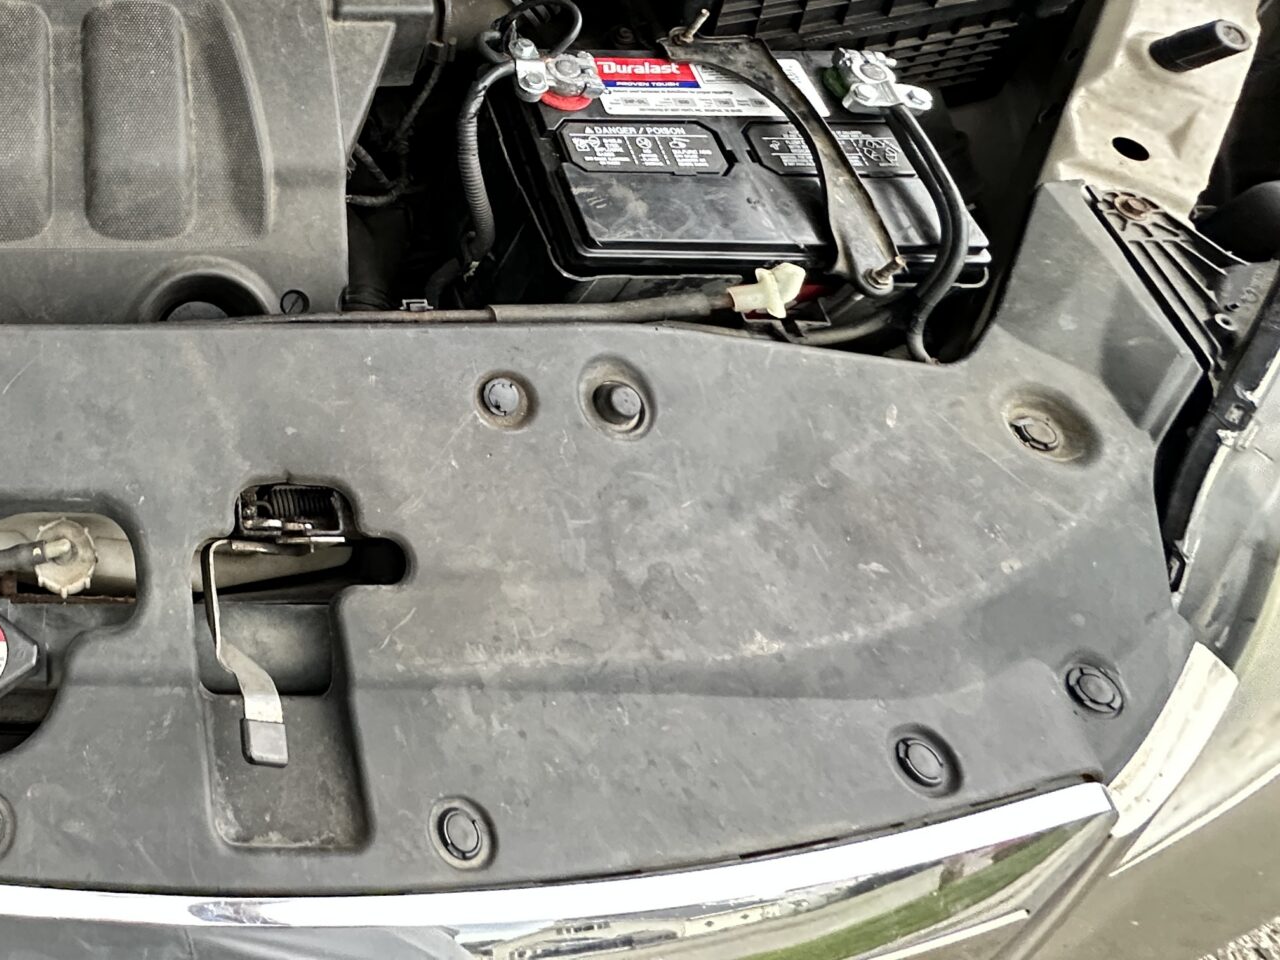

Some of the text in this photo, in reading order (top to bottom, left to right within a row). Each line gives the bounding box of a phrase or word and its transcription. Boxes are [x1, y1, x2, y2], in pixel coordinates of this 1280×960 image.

[596, 61, 680, 75] Duralast
[594, 126, 637, 134] DANGER
[646, 126, 686, 135] POISON
